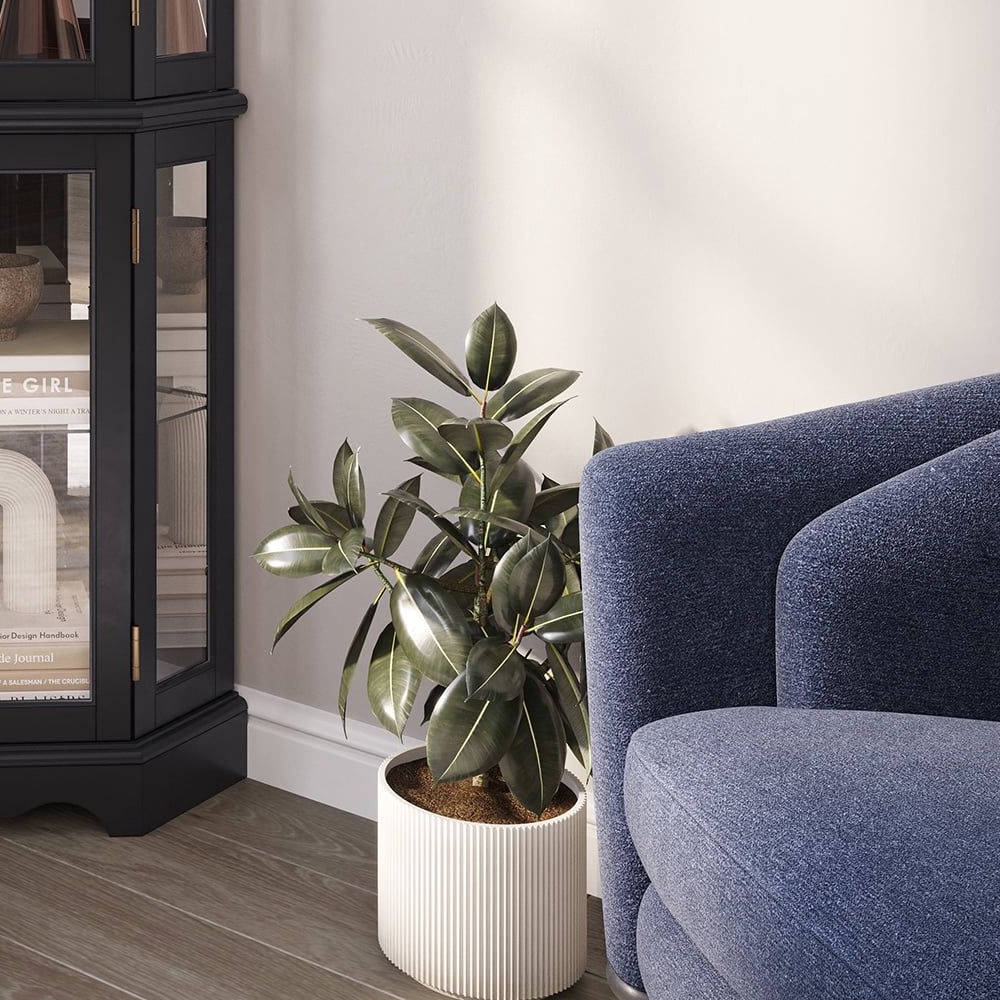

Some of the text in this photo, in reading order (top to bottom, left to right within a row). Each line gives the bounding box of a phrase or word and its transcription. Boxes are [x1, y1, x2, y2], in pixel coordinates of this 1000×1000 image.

[23, 377, 73, 393] GIRL
[14, 408, 47, 416] WINTER'S
[48, 407, 69, 415] NIGHT
[70, 407, 76, 415] A
[11, 631, 38, 640] Design
[39, 631, 80, 639] Handbook
[14, 652, 54, 665] Journal
